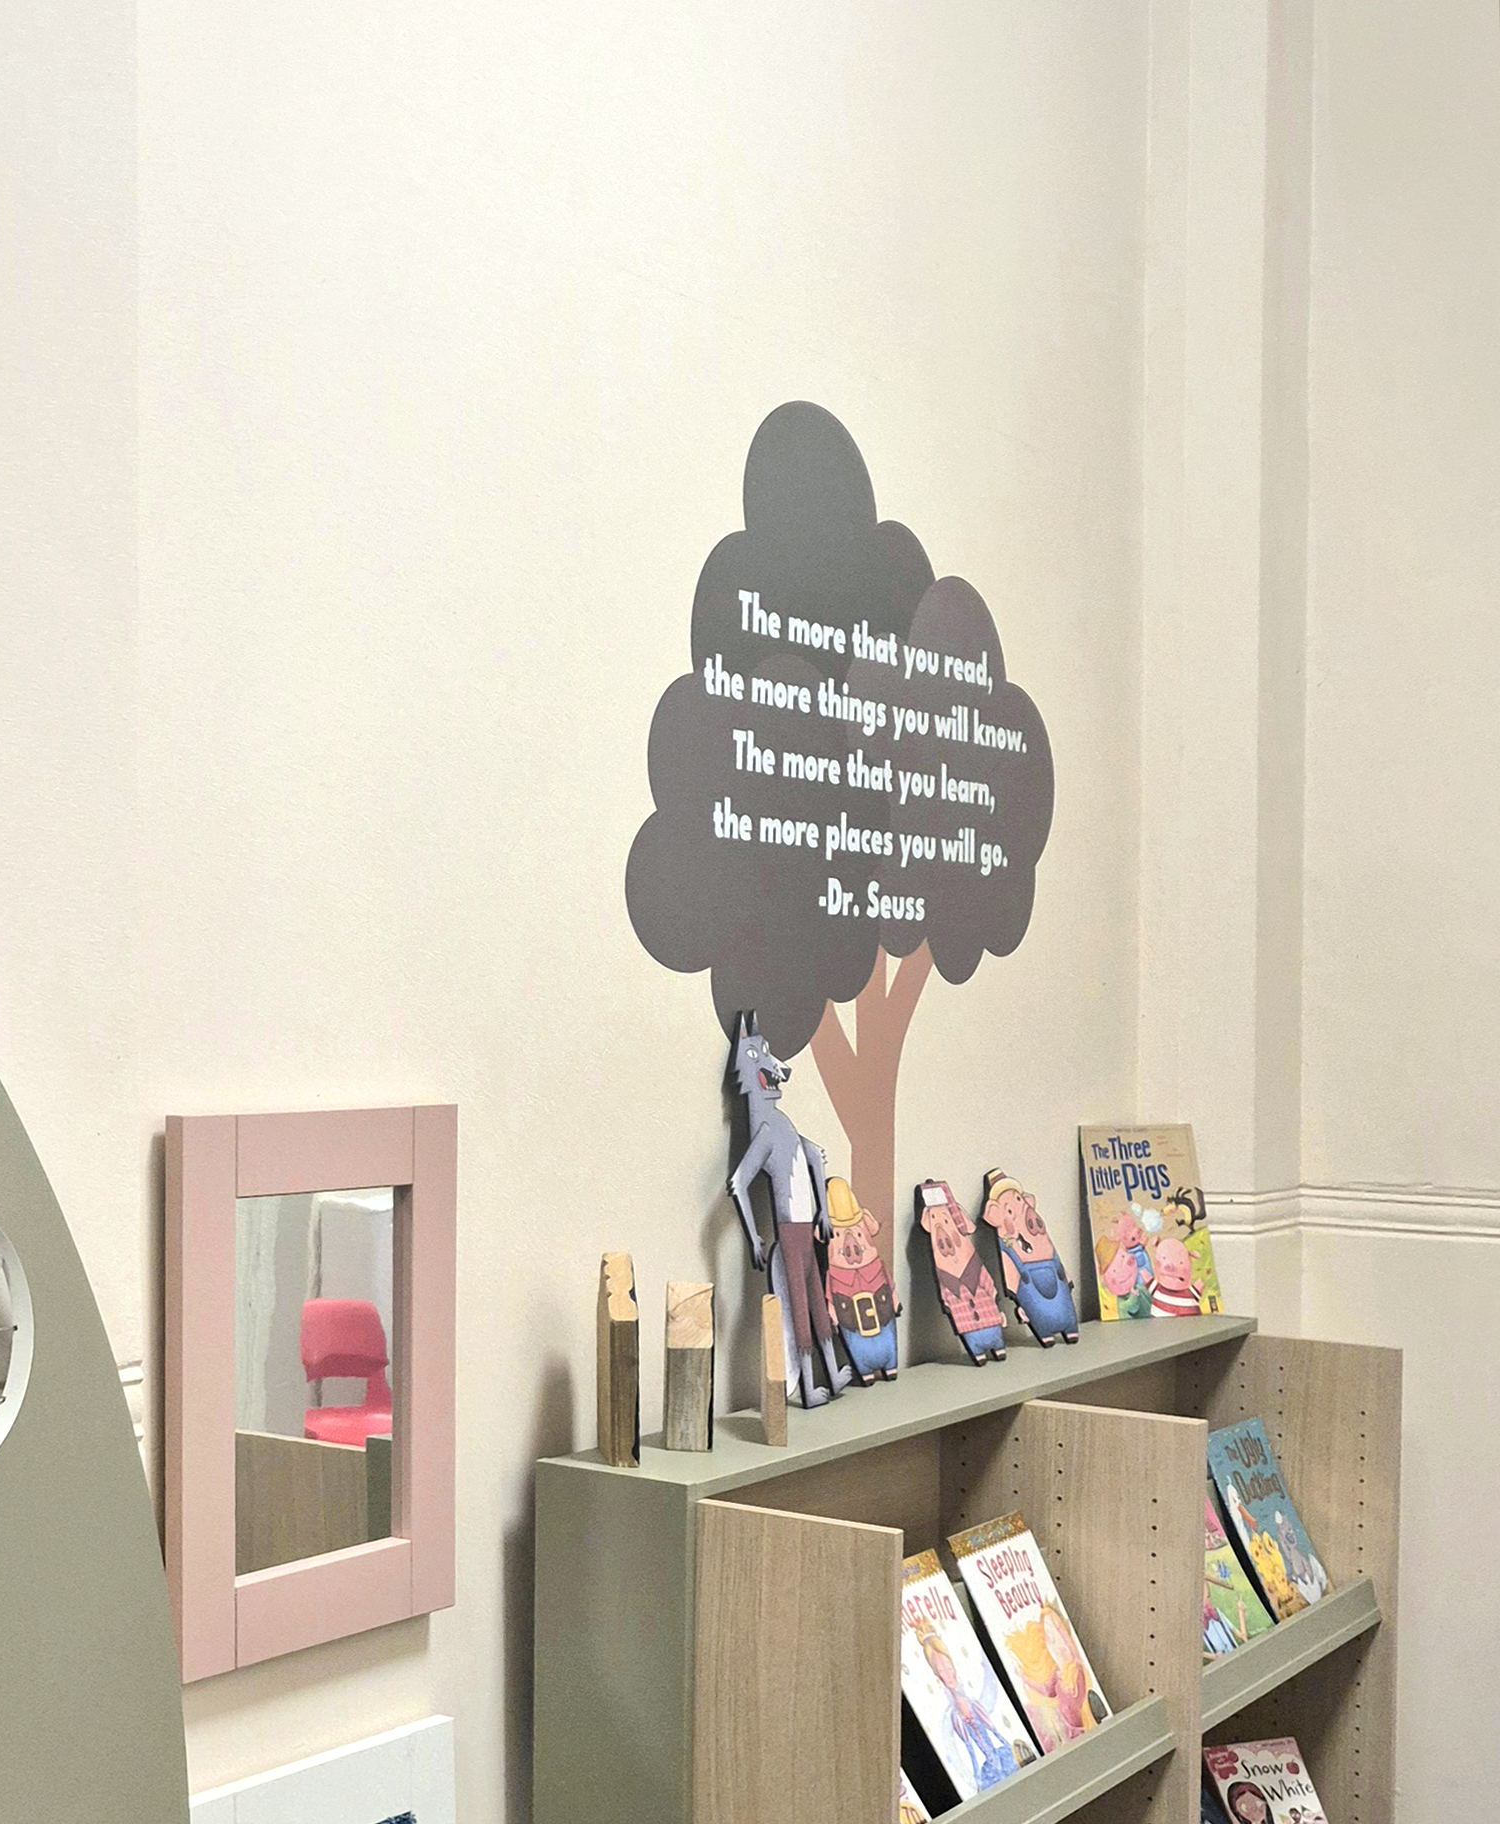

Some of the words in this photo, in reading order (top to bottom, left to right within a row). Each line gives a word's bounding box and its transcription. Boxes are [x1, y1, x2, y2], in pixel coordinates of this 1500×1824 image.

[738, 589, 781, 638] The
[788, 616, 846, 654] more
[852, 620, 898, 666] that
[903, 645, 939, 680] you
[944, 651, 993, 695] read,
[704, 653, 745, 700] the
[751, 677, 812, 714] more
[818, 677, 887, 737] things
[892, 706, 929, 741] you
[934, 704, 968, 742] will
[973, 708, 1027, 753] know.
[732, 729, 776, 775] The
[782, 752, 841, 785] more
[847, 749, 893, 792] that
[898, 770, 935, 805] you
[941, 763, 995, 814] learn,
[713, 796, 753, 841] the
[759, 816, 819, 848] more
[825, 811, 893, 861] places
[899, 834, 936, 868] you
[941, 827, 975, 864] will
[980, 842, 1008, 876] go.
[819, 877, 860, 917] -Dr.
[866, 880, 925, 921] Seuss
[1091, 1143, 1110, 1160] The
[1108, 1135, 1151, 1160] Three
[1090, 1166, 1121, 1196] Little
[1121, 1163, 1170, 1201] Pigs
[976, 1546, 1034, 1589] Sleeping
[994, 1578, 1044, 1620] Beauty
[1241, 1759, 1284, 1779] Snow
[1262, 1779, 1314, 1802] White
